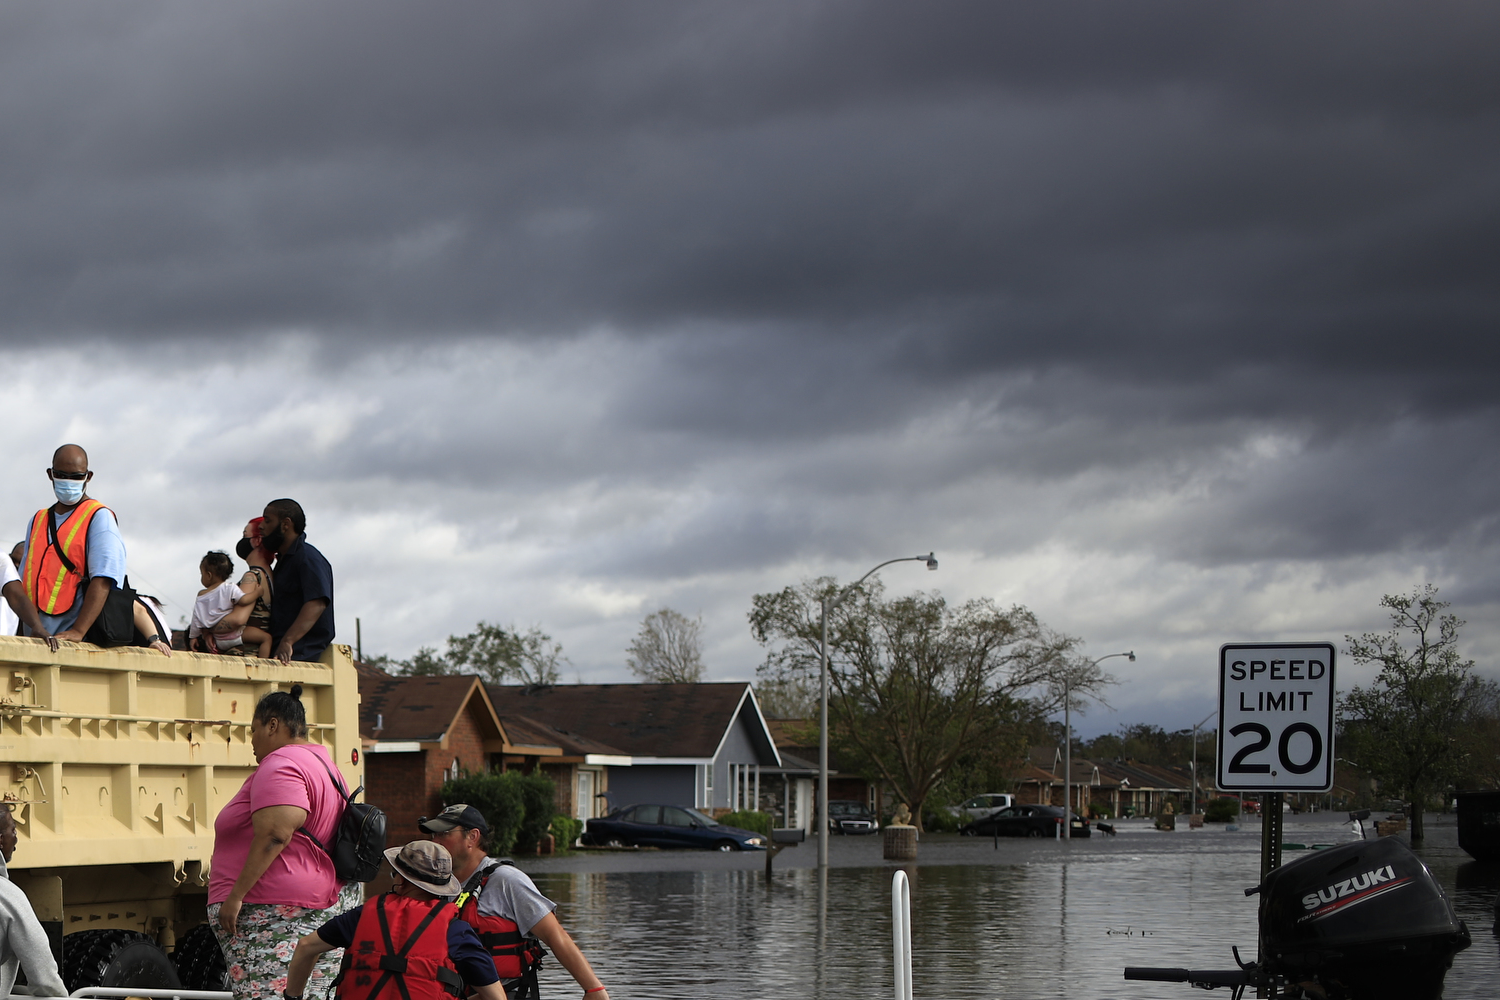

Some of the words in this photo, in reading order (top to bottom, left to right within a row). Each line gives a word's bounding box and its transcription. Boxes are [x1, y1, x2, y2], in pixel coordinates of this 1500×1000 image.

[1230, 660, 1325, 681] SPEED
[1240, 691, 1313, 711] LIMIT
[1228, 722, 1323, 774] 20
[1301, 865, 1396, 910] SUZUKI
